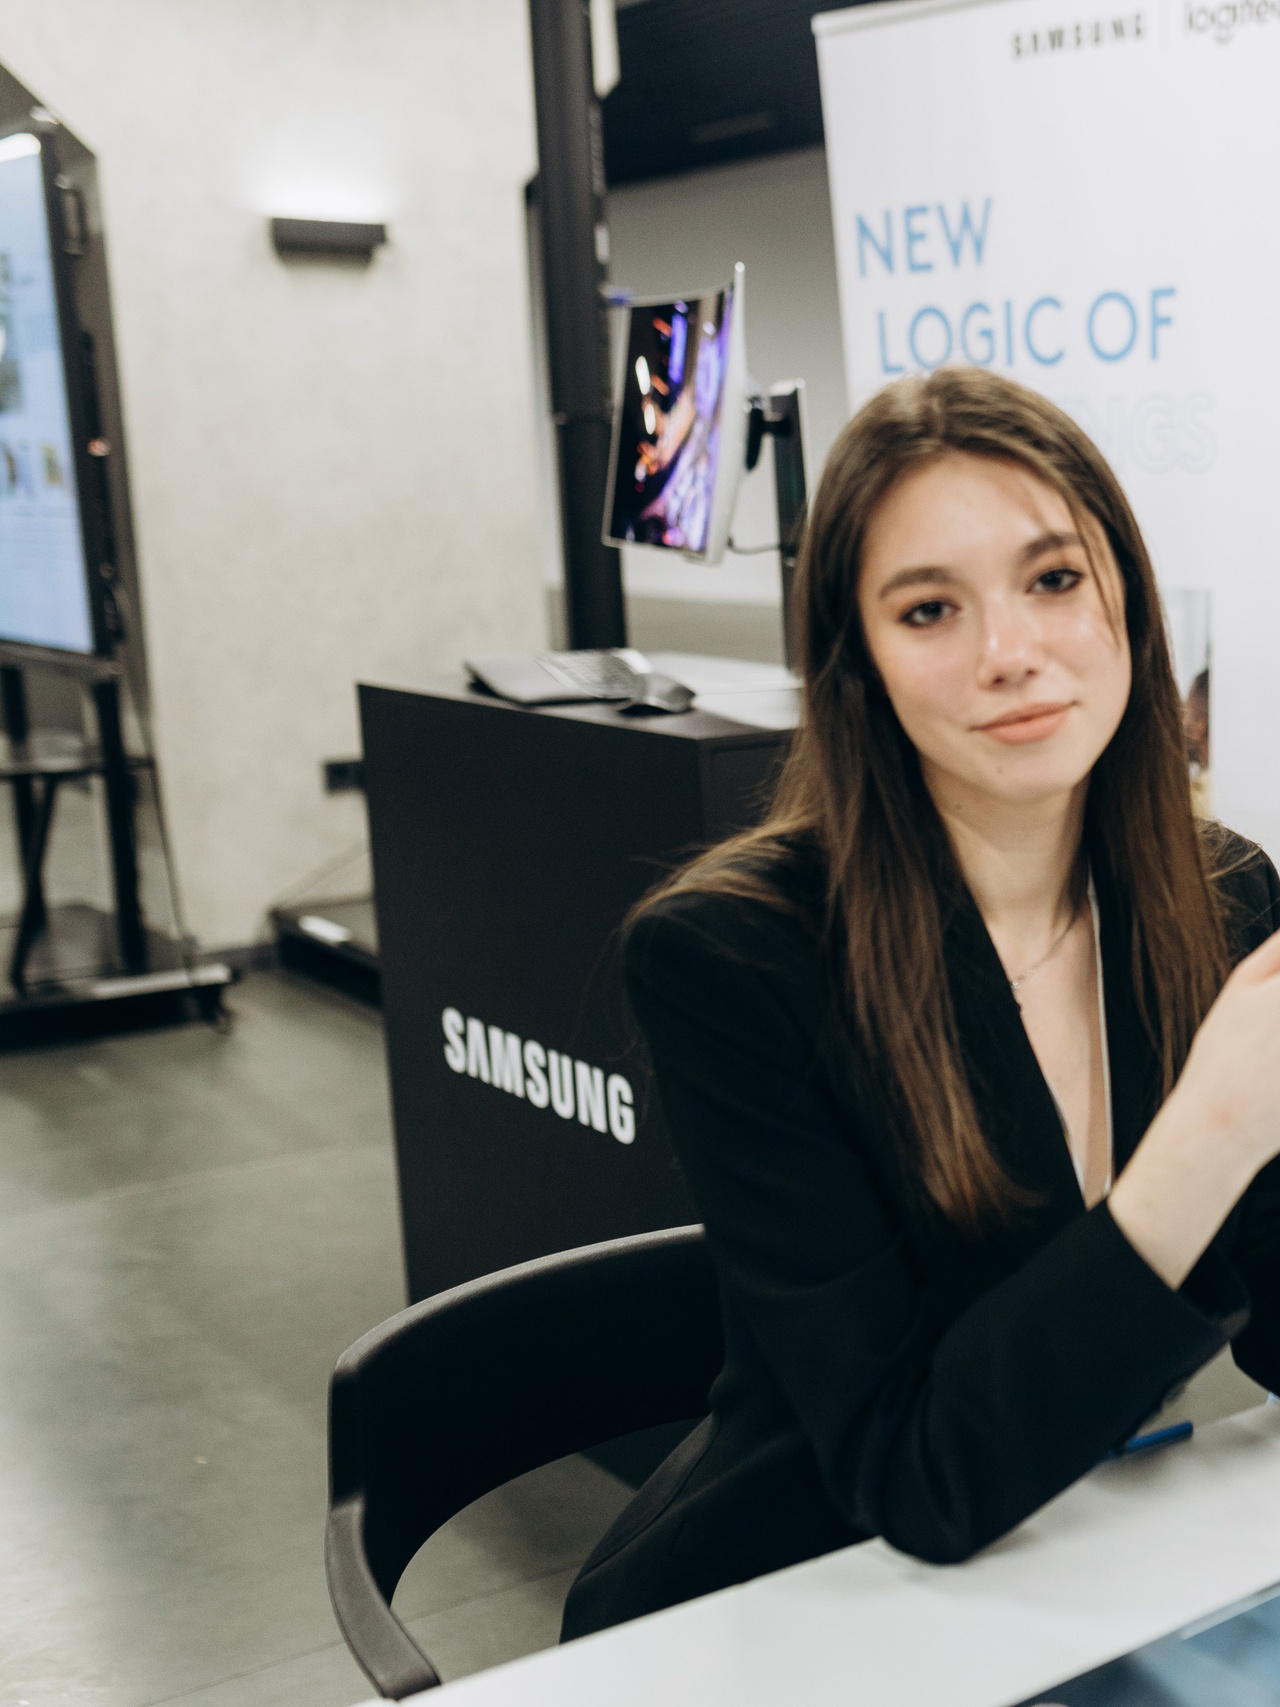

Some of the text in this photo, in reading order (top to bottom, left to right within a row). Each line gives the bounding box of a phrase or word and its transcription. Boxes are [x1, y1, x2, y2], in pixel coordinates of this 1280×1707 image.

[1011, 13, 1146, 58] SAMSUNG
[855, 197, 992, 278] NEW
[877, 286, 1176, 375] LOGIC OF
[441, 1006, 635, 1145] SAMSUNG
